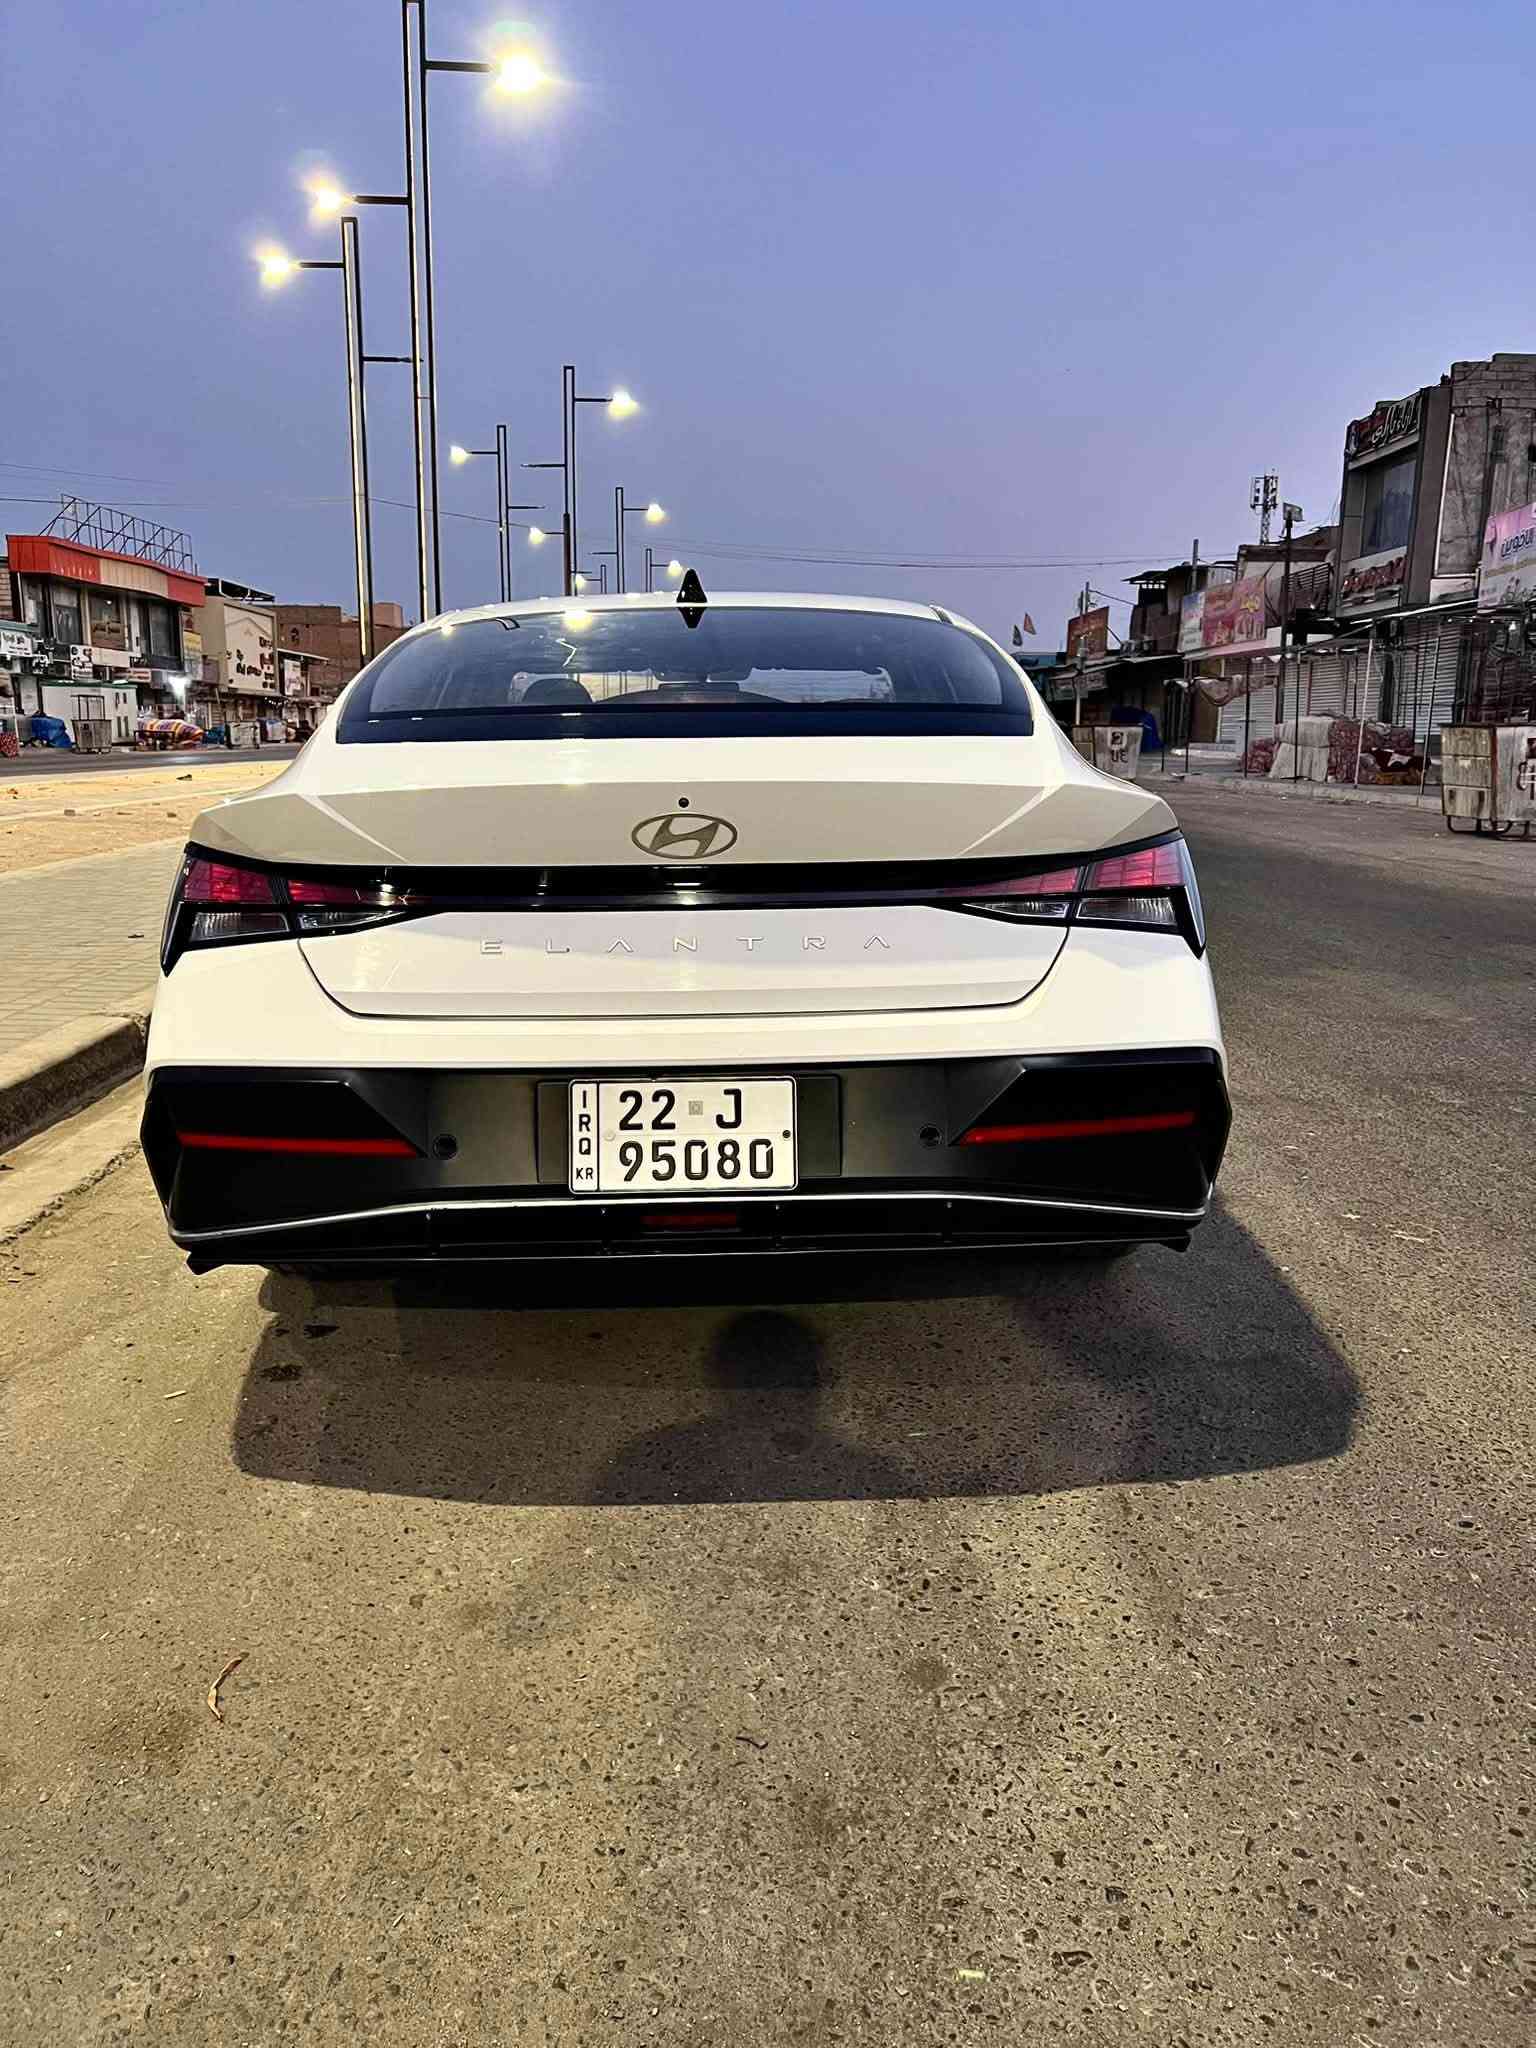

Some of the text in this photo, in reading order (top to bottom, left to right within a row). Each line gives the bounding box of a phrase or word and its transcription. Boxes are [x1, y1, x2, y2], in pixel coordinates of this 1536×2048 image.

[480, 935, 891, 954] ELANTRA
[578, 1090, 592, 1155] IRQ
[619, 1088, 742, 1131] 22 J
[575, 1167, 594, 1180] KR
[619, 1138, 774, 1181] 95080
